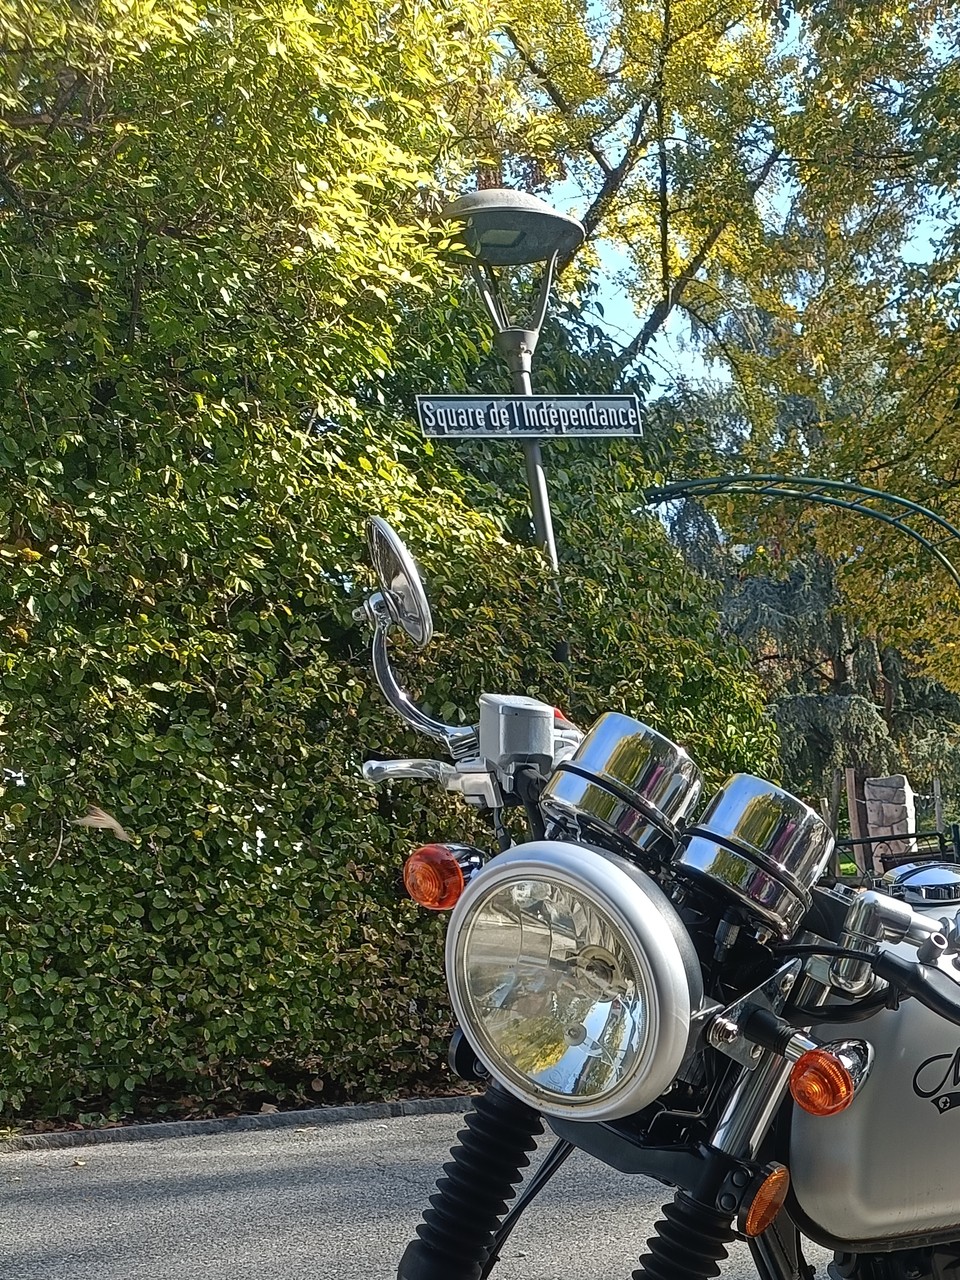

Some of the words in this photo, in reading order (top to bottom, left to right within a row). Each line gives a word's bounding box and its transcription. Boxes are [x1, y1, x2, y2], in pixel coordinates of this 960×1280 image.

[422, 401, 485, 433] Square
[489, 401, 511, 427] de
[513, 401, 638, 433] l'Indépendance
